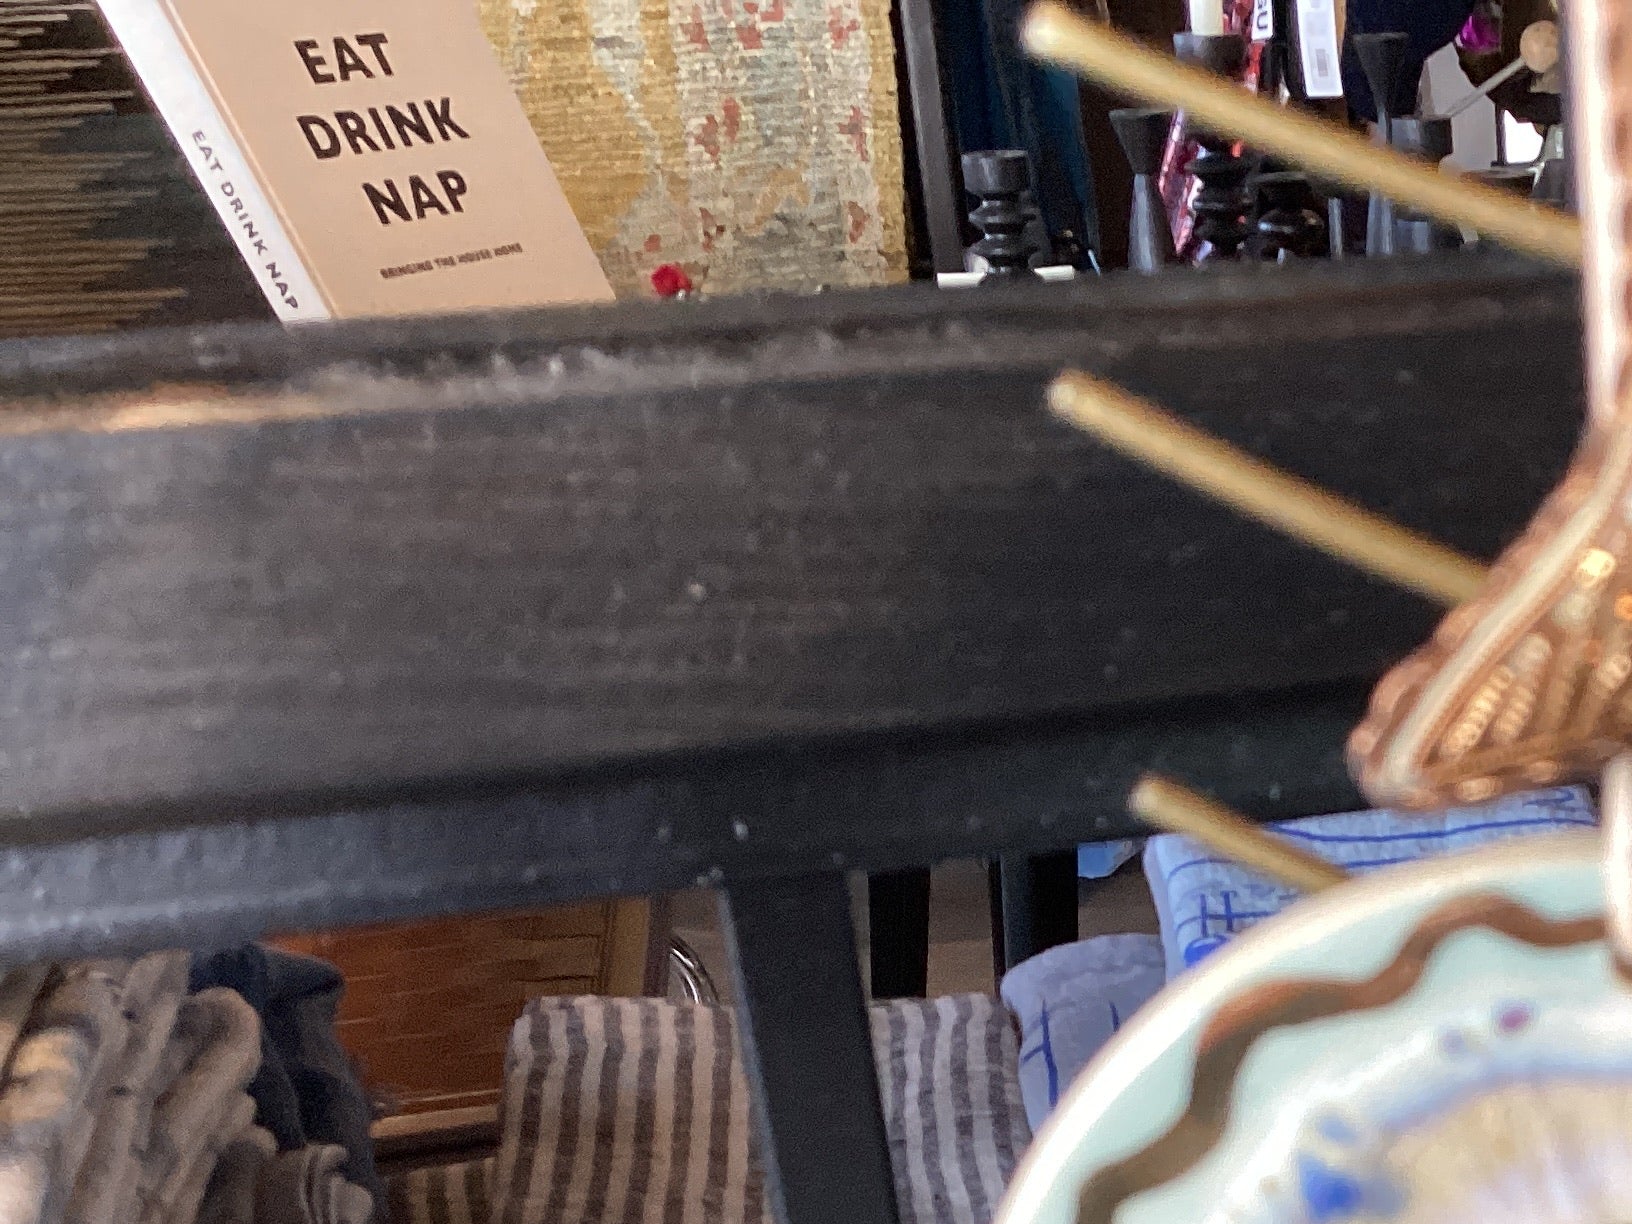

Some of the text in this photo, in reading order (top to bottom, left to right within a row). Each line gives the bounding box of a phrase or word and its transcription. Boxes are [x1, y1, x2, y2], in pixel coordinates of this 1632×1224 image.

[293, 32, 395, 85] EAT
[296, 96, 471, 160] DRINK
[192, 129, 299, 309] EAT DRINK NAP
[361, 169, 468, 225] NAP
